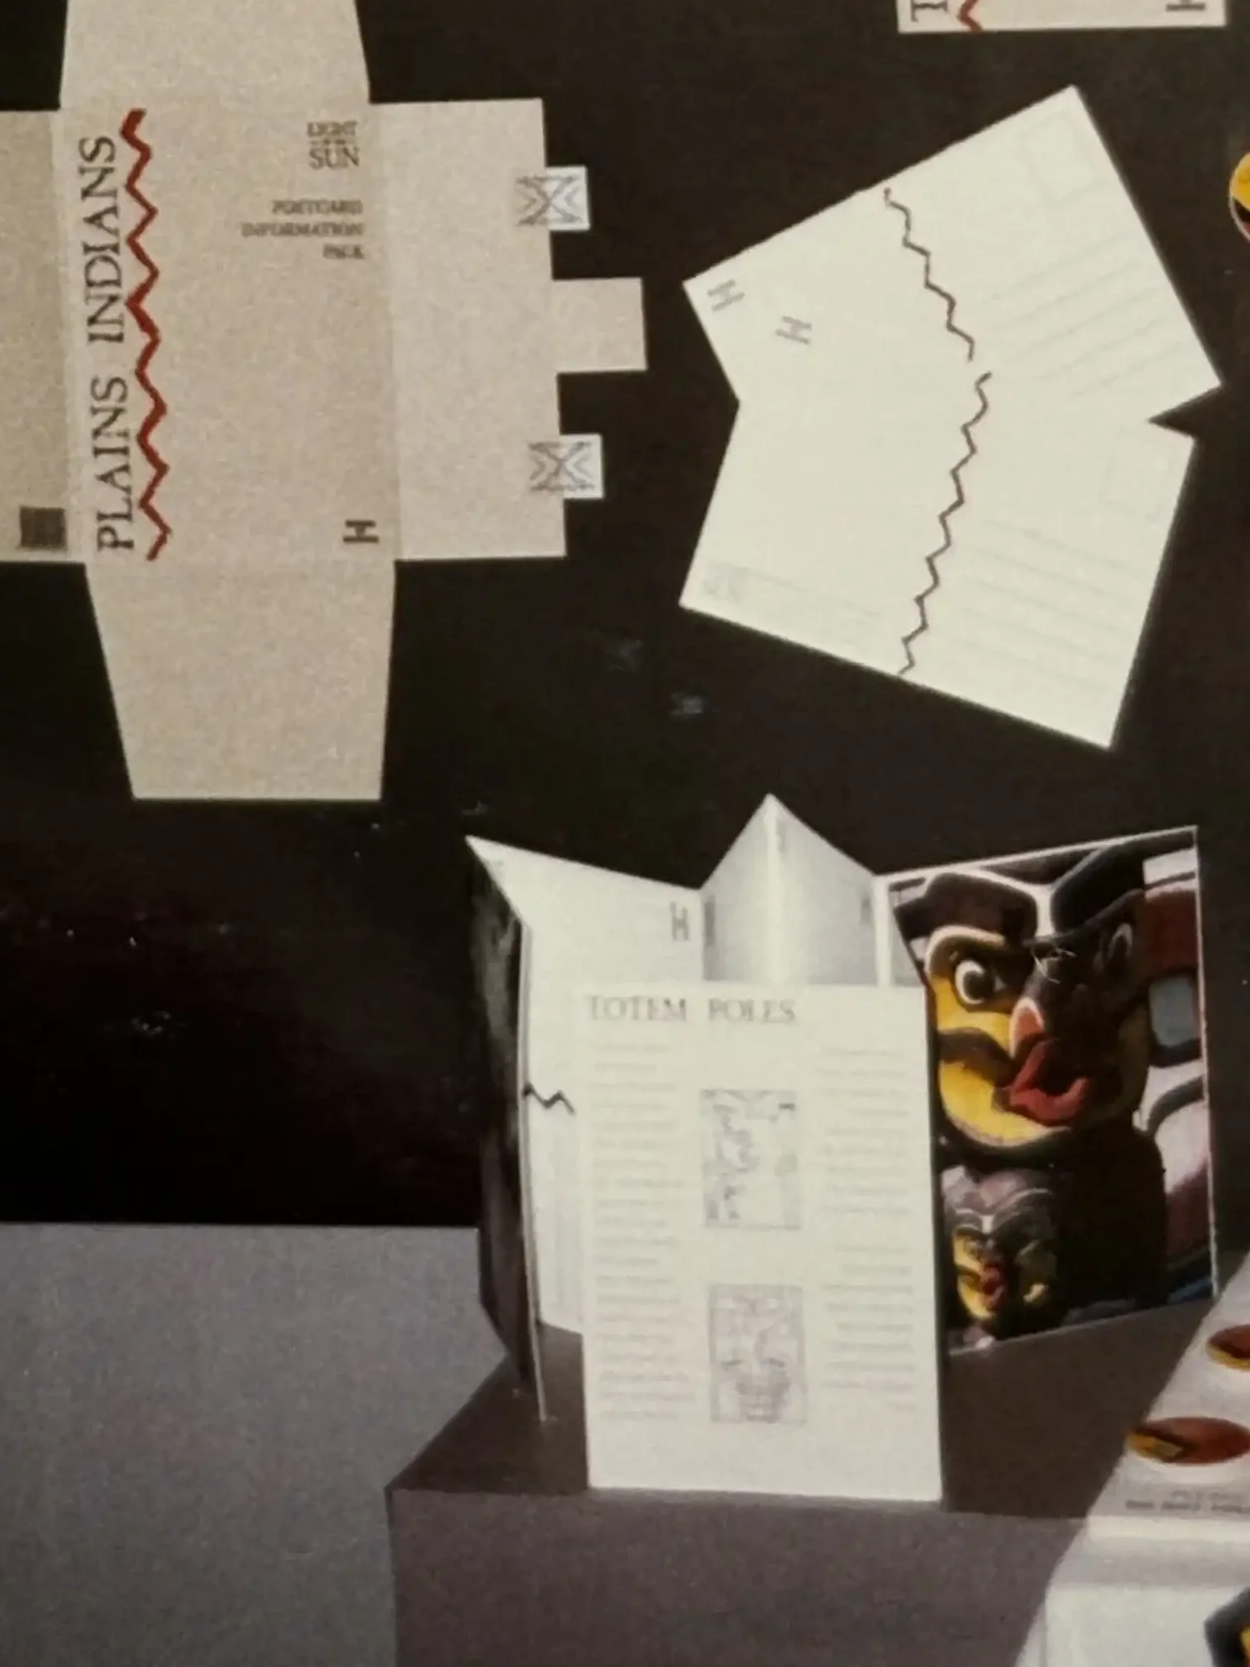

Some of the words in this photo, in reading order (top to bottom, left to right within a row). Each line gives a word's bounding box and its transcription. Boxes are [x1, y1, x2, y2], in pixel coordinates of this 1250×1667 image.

[308, 146, 361, 170] SUN
[78, 134, 125, 344] INDIANS
[89, 376, 136, 552] PLAINS
[586, 994, 687, 1023] TOTEM
[707, 997, 797, 1025] POLES
